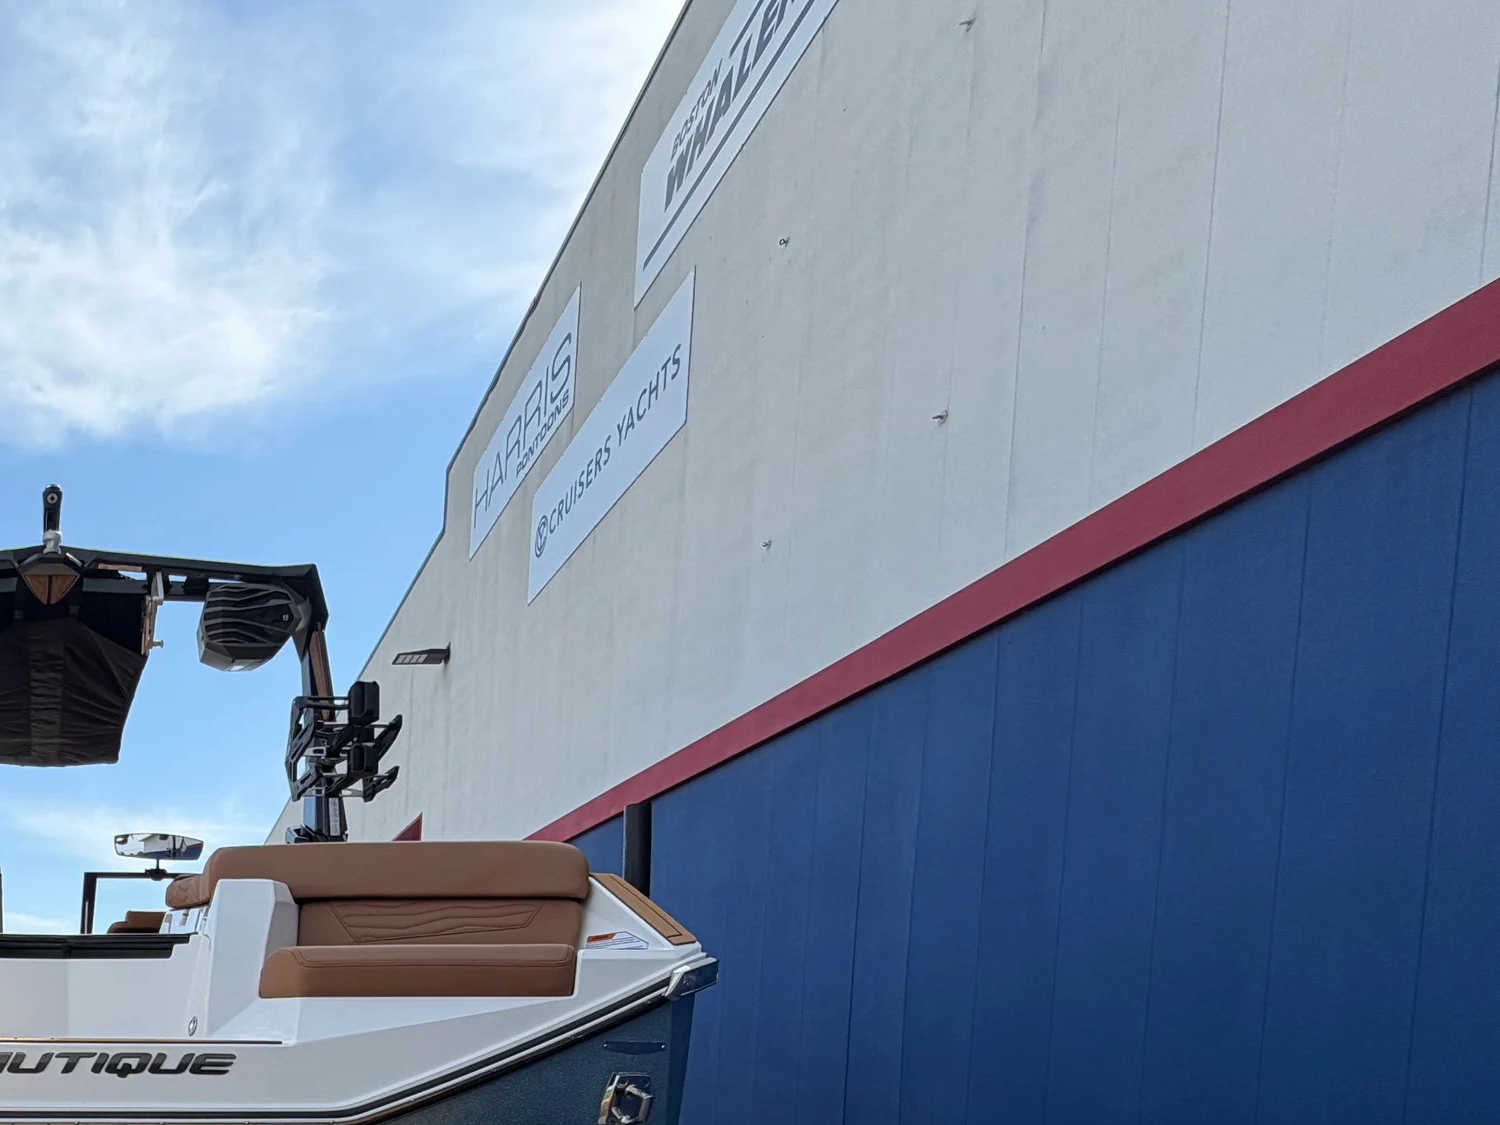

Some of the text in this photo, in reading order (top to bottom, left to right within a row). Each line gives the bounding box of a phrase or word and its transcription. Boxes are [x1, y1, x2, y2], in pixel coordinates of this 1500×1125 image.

[670, 58, 723, 163] BOSTON
[473, 332, 572, 529] HARRIS
[516, 388, 570, 480] PONTOONS
[549, 343, 682, 534] CRUISERS YACHTS
